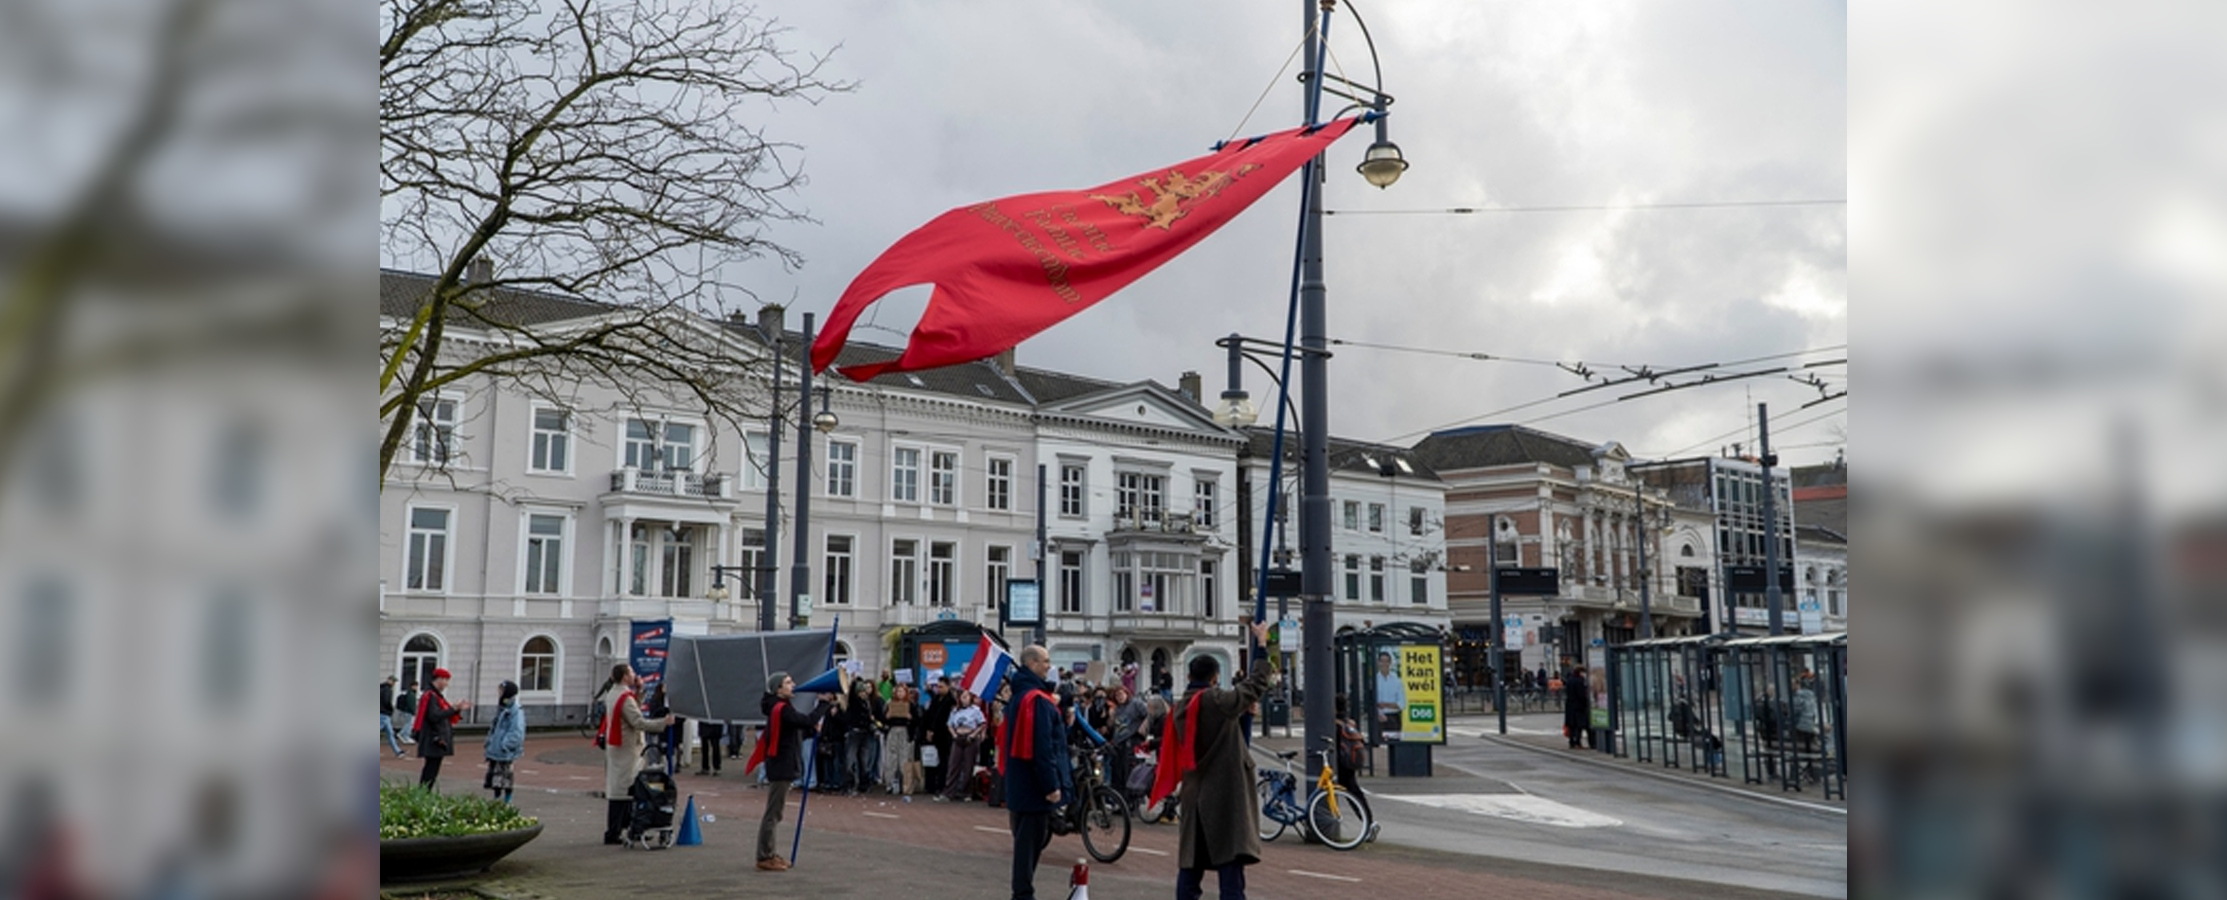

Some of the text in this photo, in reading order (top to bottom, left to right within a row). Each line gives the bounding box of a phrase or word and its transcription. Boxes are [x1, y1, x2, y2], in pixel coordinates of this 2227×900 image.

[1406, 652, 1433, 664] Het
[1407, 666, 1435, 678] kan
[1408, 679, 1435, 691] wél
[1411, 708, 1433, 719] D66
